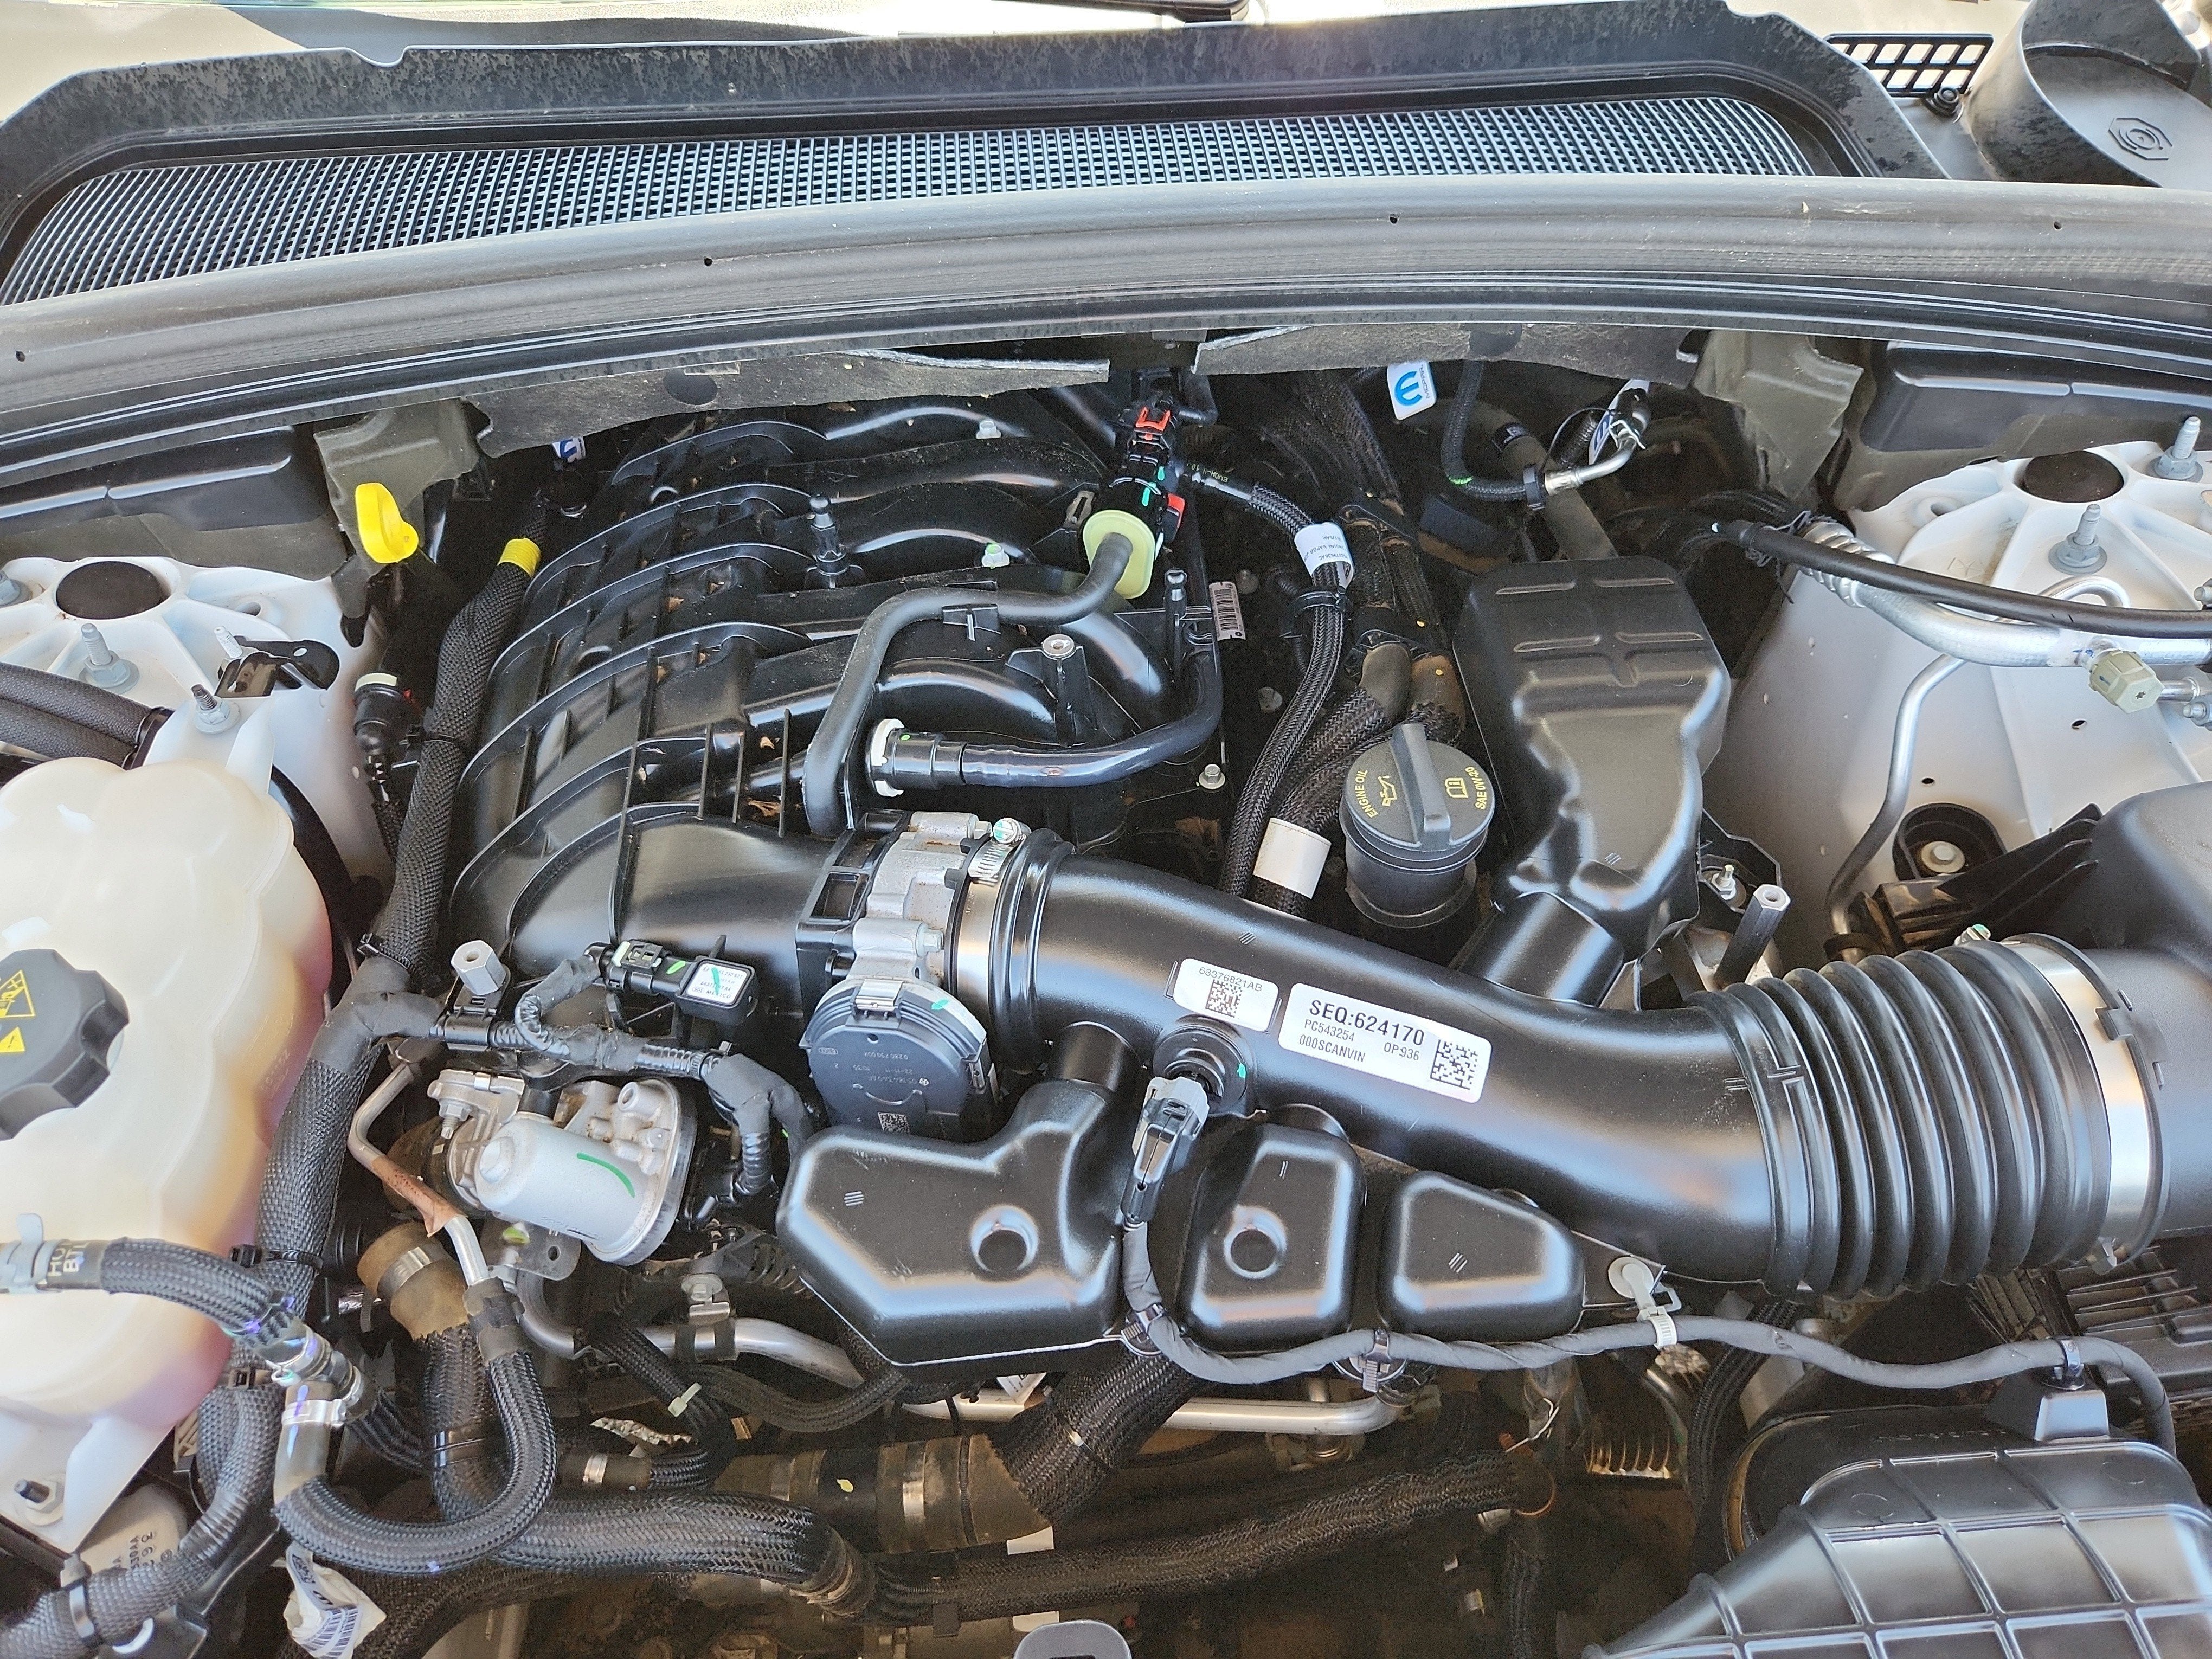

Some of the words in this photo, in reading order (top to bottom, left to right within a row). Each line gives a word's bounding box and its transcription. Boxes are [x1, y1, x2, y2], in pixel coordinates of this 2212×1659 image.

[1310, 545, 1327, 554] VAPOR
[1355, 770, 1368, 783] OIL
[1465, 766, 1487, 790] 0W-20
[1354, 785, 1378, 818] ENGINE
[1475, 791, 1487, 809] SAE
[1199, 967, 1263, 992] 68376821AB
[1304, 1019, 1355, 1042] PC543254
[1309, 999, 1425, 1046] SEQ:624170
[1299, 1034, 1366, 1063] 000SCANVIN
